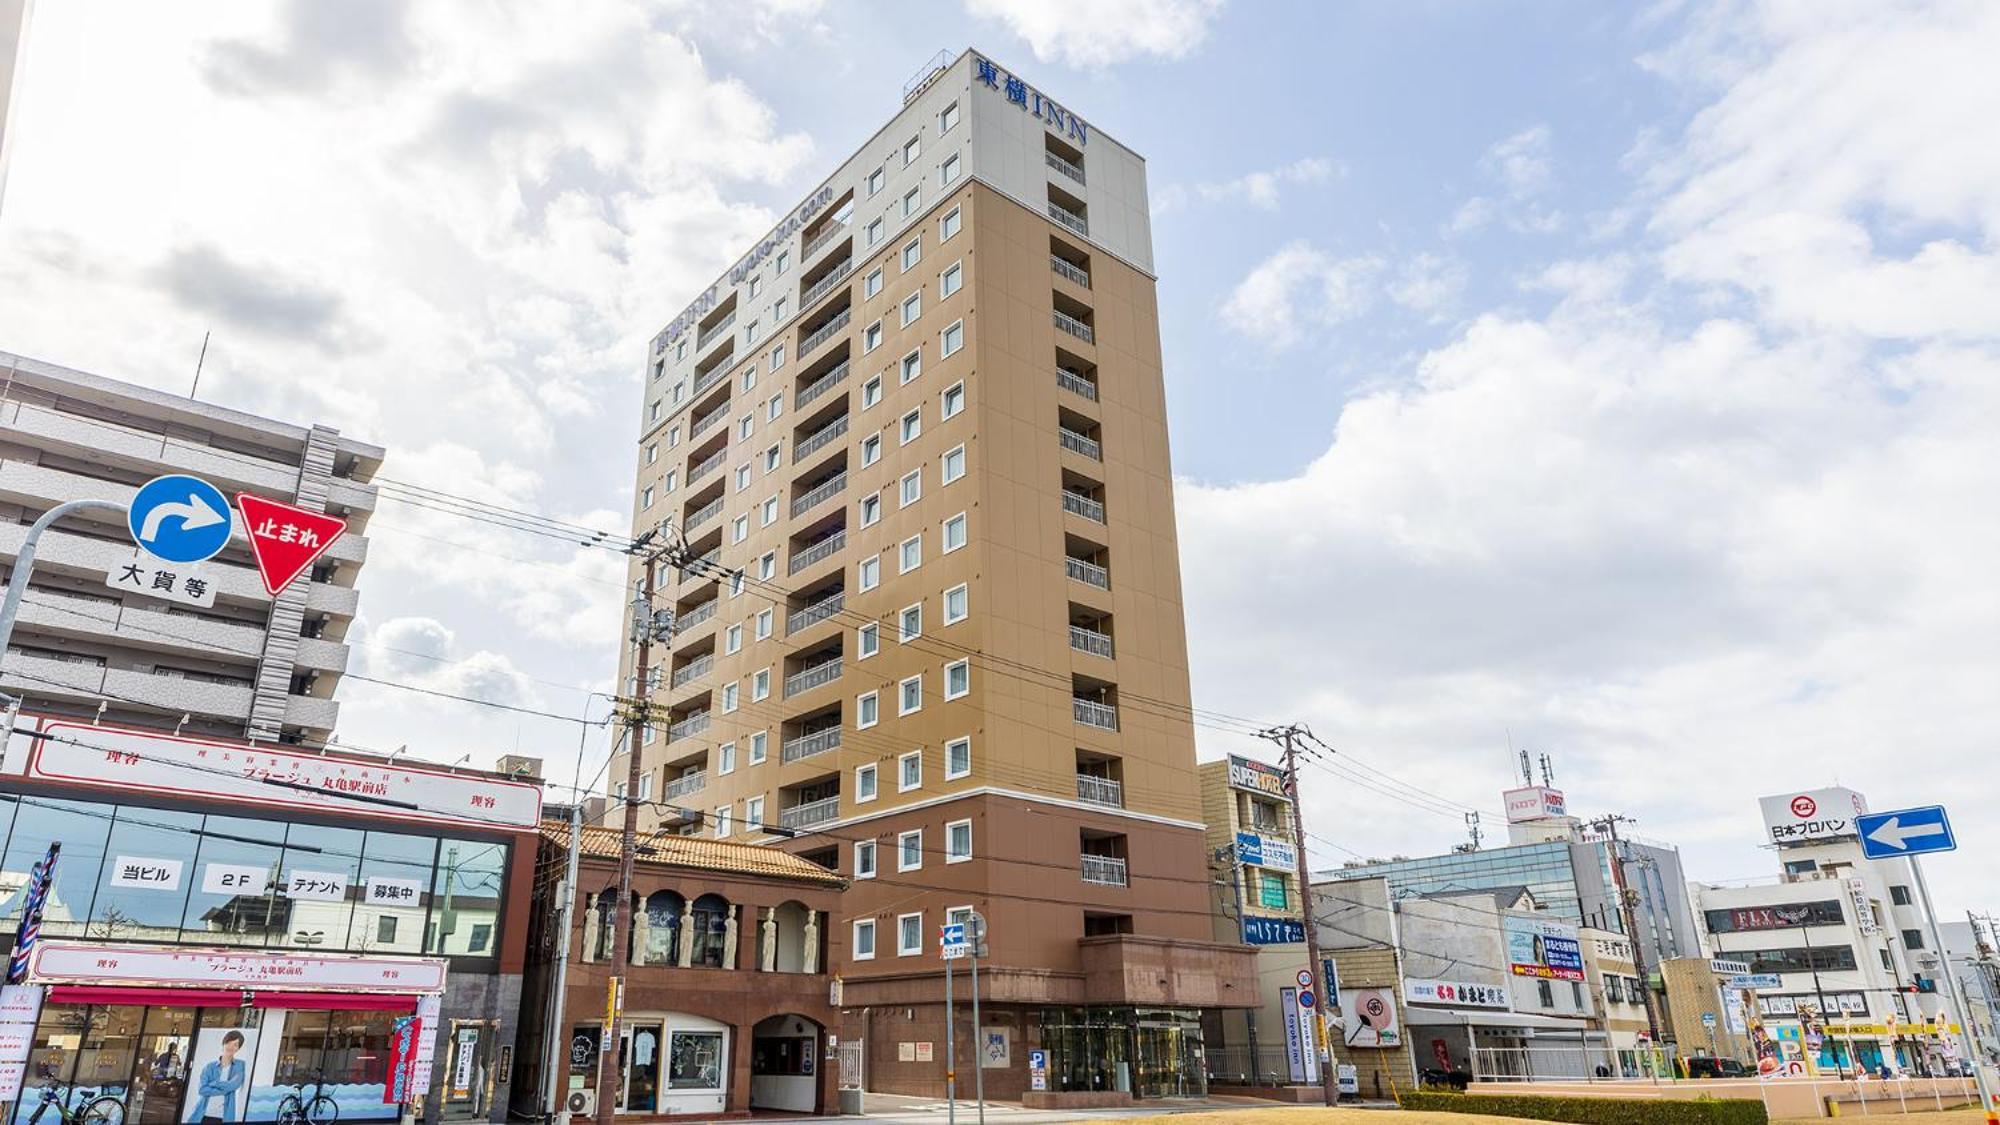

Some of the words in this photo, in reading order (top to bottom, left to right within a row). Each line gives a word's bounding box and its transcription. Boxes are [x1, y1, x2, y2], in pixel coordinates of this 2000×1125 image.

[976, 57, 1090, 145] 東横INN
[255, 518, 320, 549] 止まれ
[118, 563, 208, 598] 大貨等
[322, 776, 388, 796] 丸亀駅前店
[1771, 820, 1846, 838] 日本プロパン
[122, 865, 170, 882] 当ビル
[294, 879, 341, 894] テナント
[374, 884, 414, 900] 募集中
[1458, 984, 1486, 1003] かまど
[1288, 1013, 1297, 1048] toyoko
[1033, 1053, 1043, 1063] P
